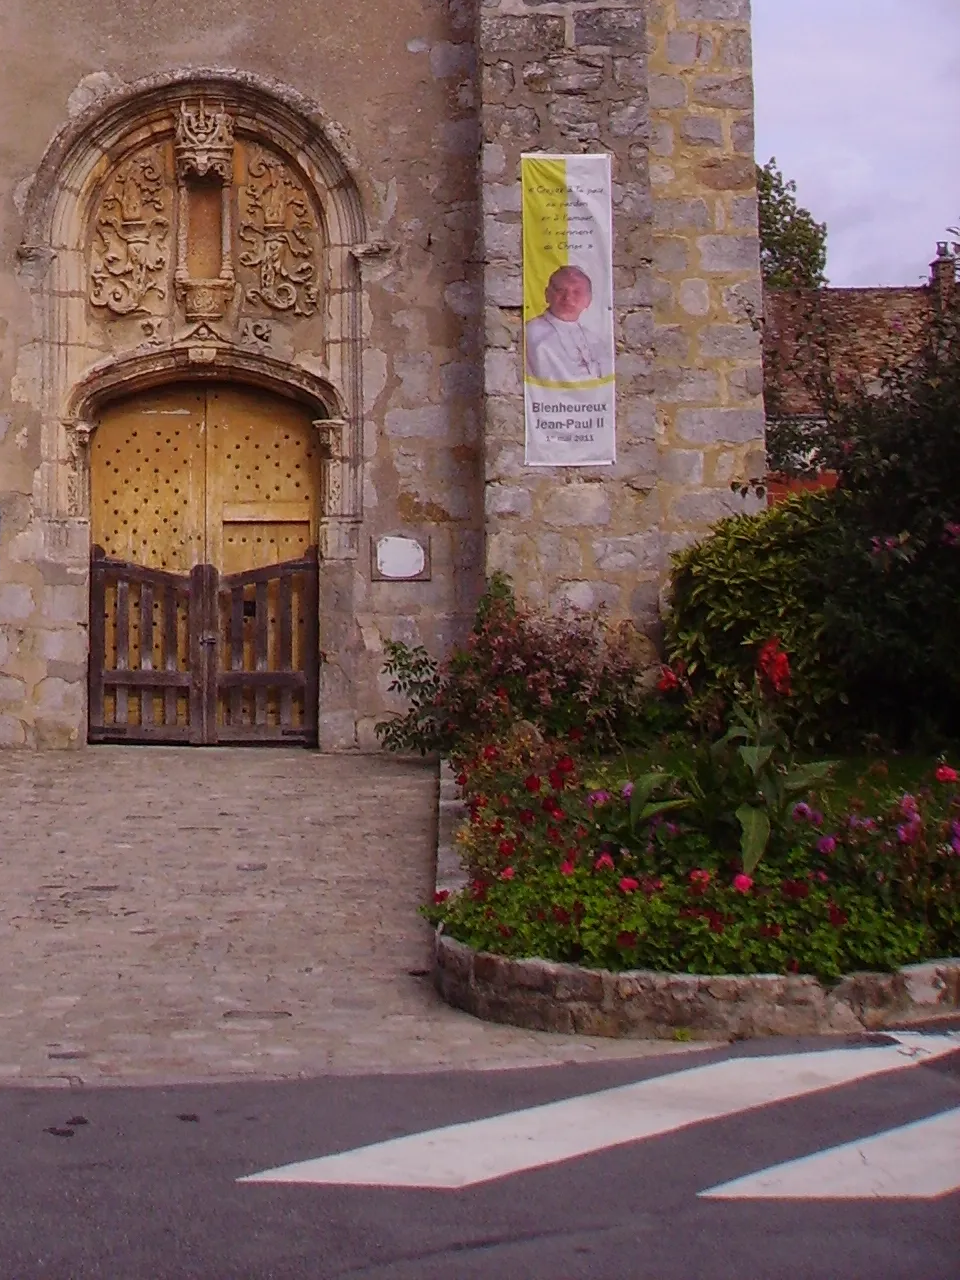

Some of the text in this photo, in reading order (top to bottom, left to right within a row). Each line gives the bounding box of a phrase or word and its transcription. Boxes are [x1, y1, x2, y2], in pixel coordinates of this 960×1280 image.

[531, 402, 608, 413] Bienheureux
[535, 418, 604, 430] Jean-Paul II
[574, 434, 594, 442] 2011
